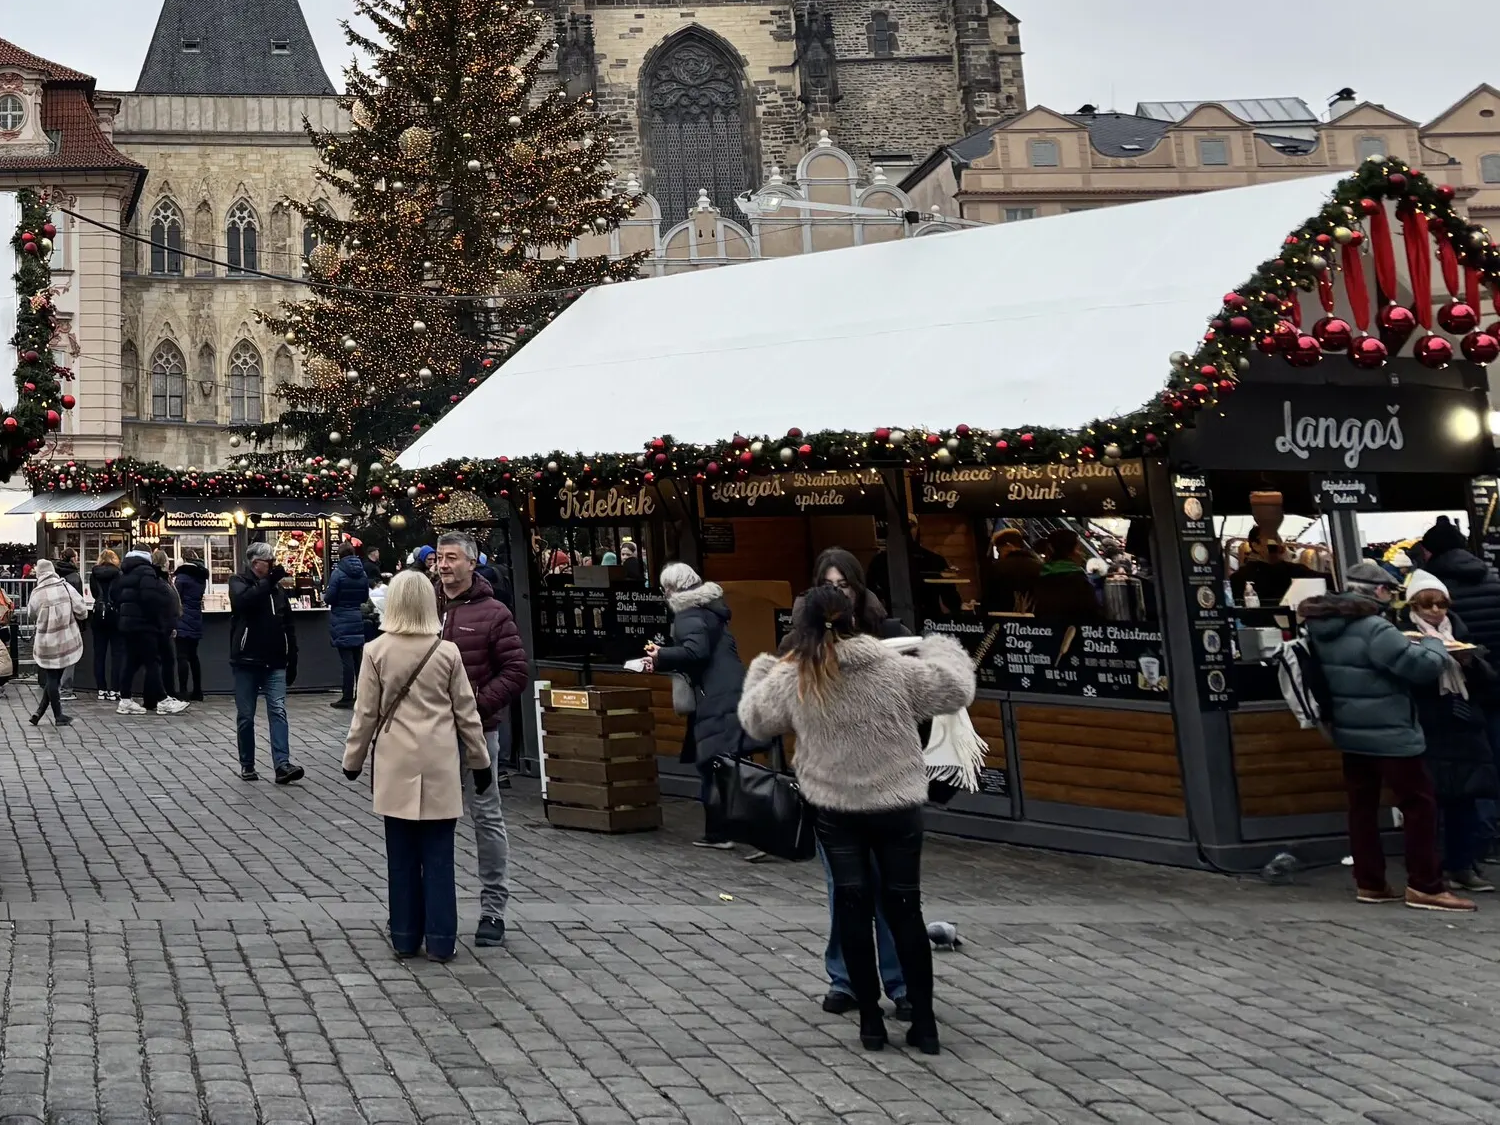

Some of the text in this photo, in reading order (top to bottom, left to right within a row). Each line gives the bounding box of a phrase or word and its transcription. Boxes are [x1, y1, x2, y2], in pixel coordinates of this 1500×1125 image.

[1275, 401, 1404, 469] Langoš
[712, 474, 781, 506] Langoš
[922, 484, 960, 509] Dog
[794, 489, 845, 511] spirála
[52, 520, 120, 529] PRAGUE CHOCOLATE
[167, 519, 231, 528] PRAGUE CHOCOLATE
[615, 591, 630, 601] Hot
[616, 602, 638, 612] Drink
[923, 618, 986, 634] Bramborová
[1003, 622, 1162, 642] Maraca Hot Christmas
[1005, 635, 1119, 654] Dog Drink
